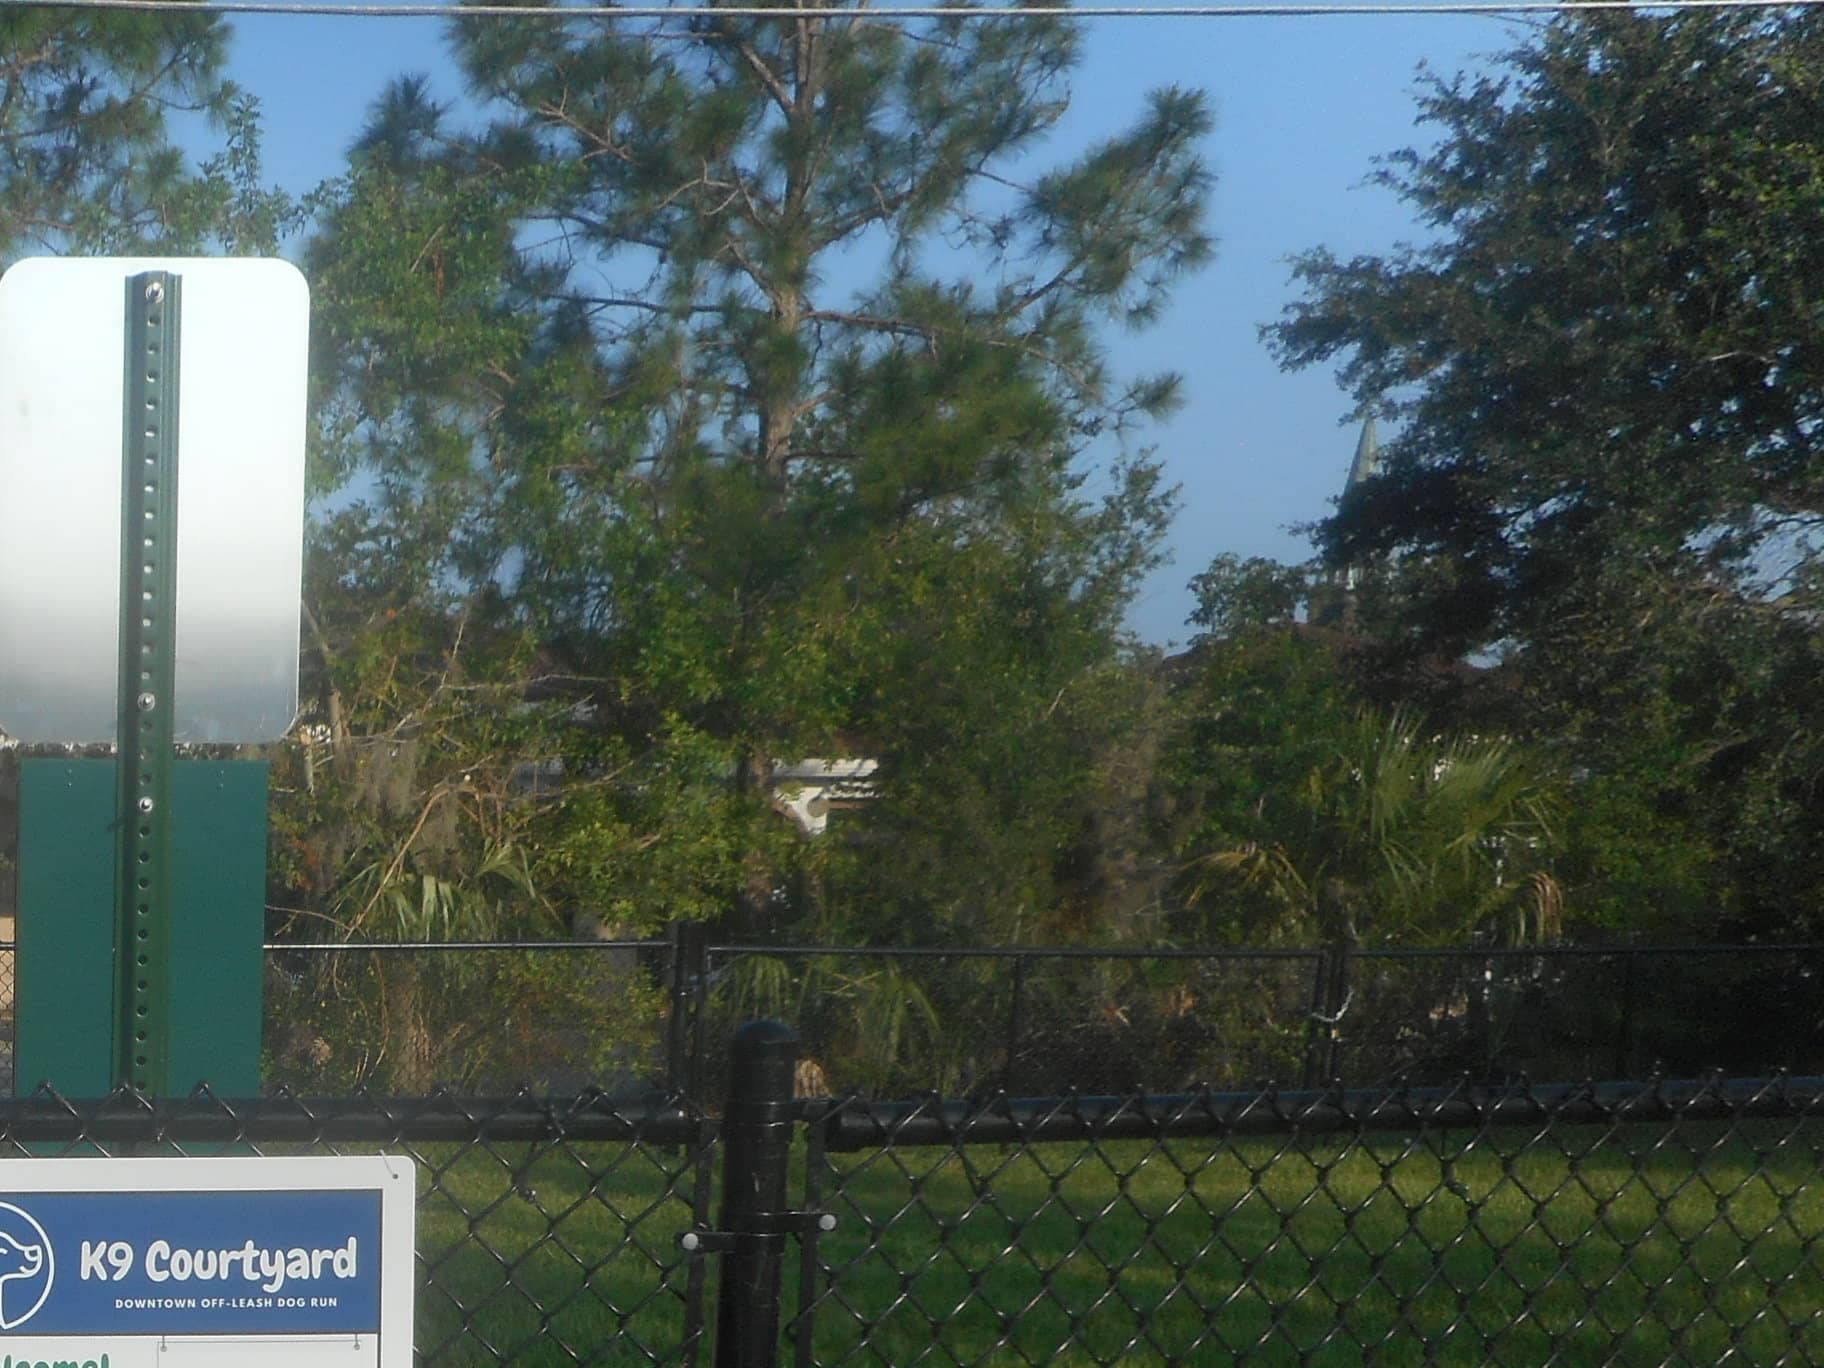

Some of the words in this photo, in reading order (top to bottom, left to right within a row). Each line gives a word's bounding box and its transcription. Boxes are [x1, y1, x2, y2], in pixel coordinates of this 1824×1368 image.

[80, 1240, 133, 1281] K9
[145, 1237, 356, 1293] Courtyard
[115, 1298, 195, 1308] DOWNTOWN
[201, 1298, 272, 1307] OFF-LEASH
[277, 1297, 305, 1307] DOG
[311, 1297, 336, 1307] RUN
